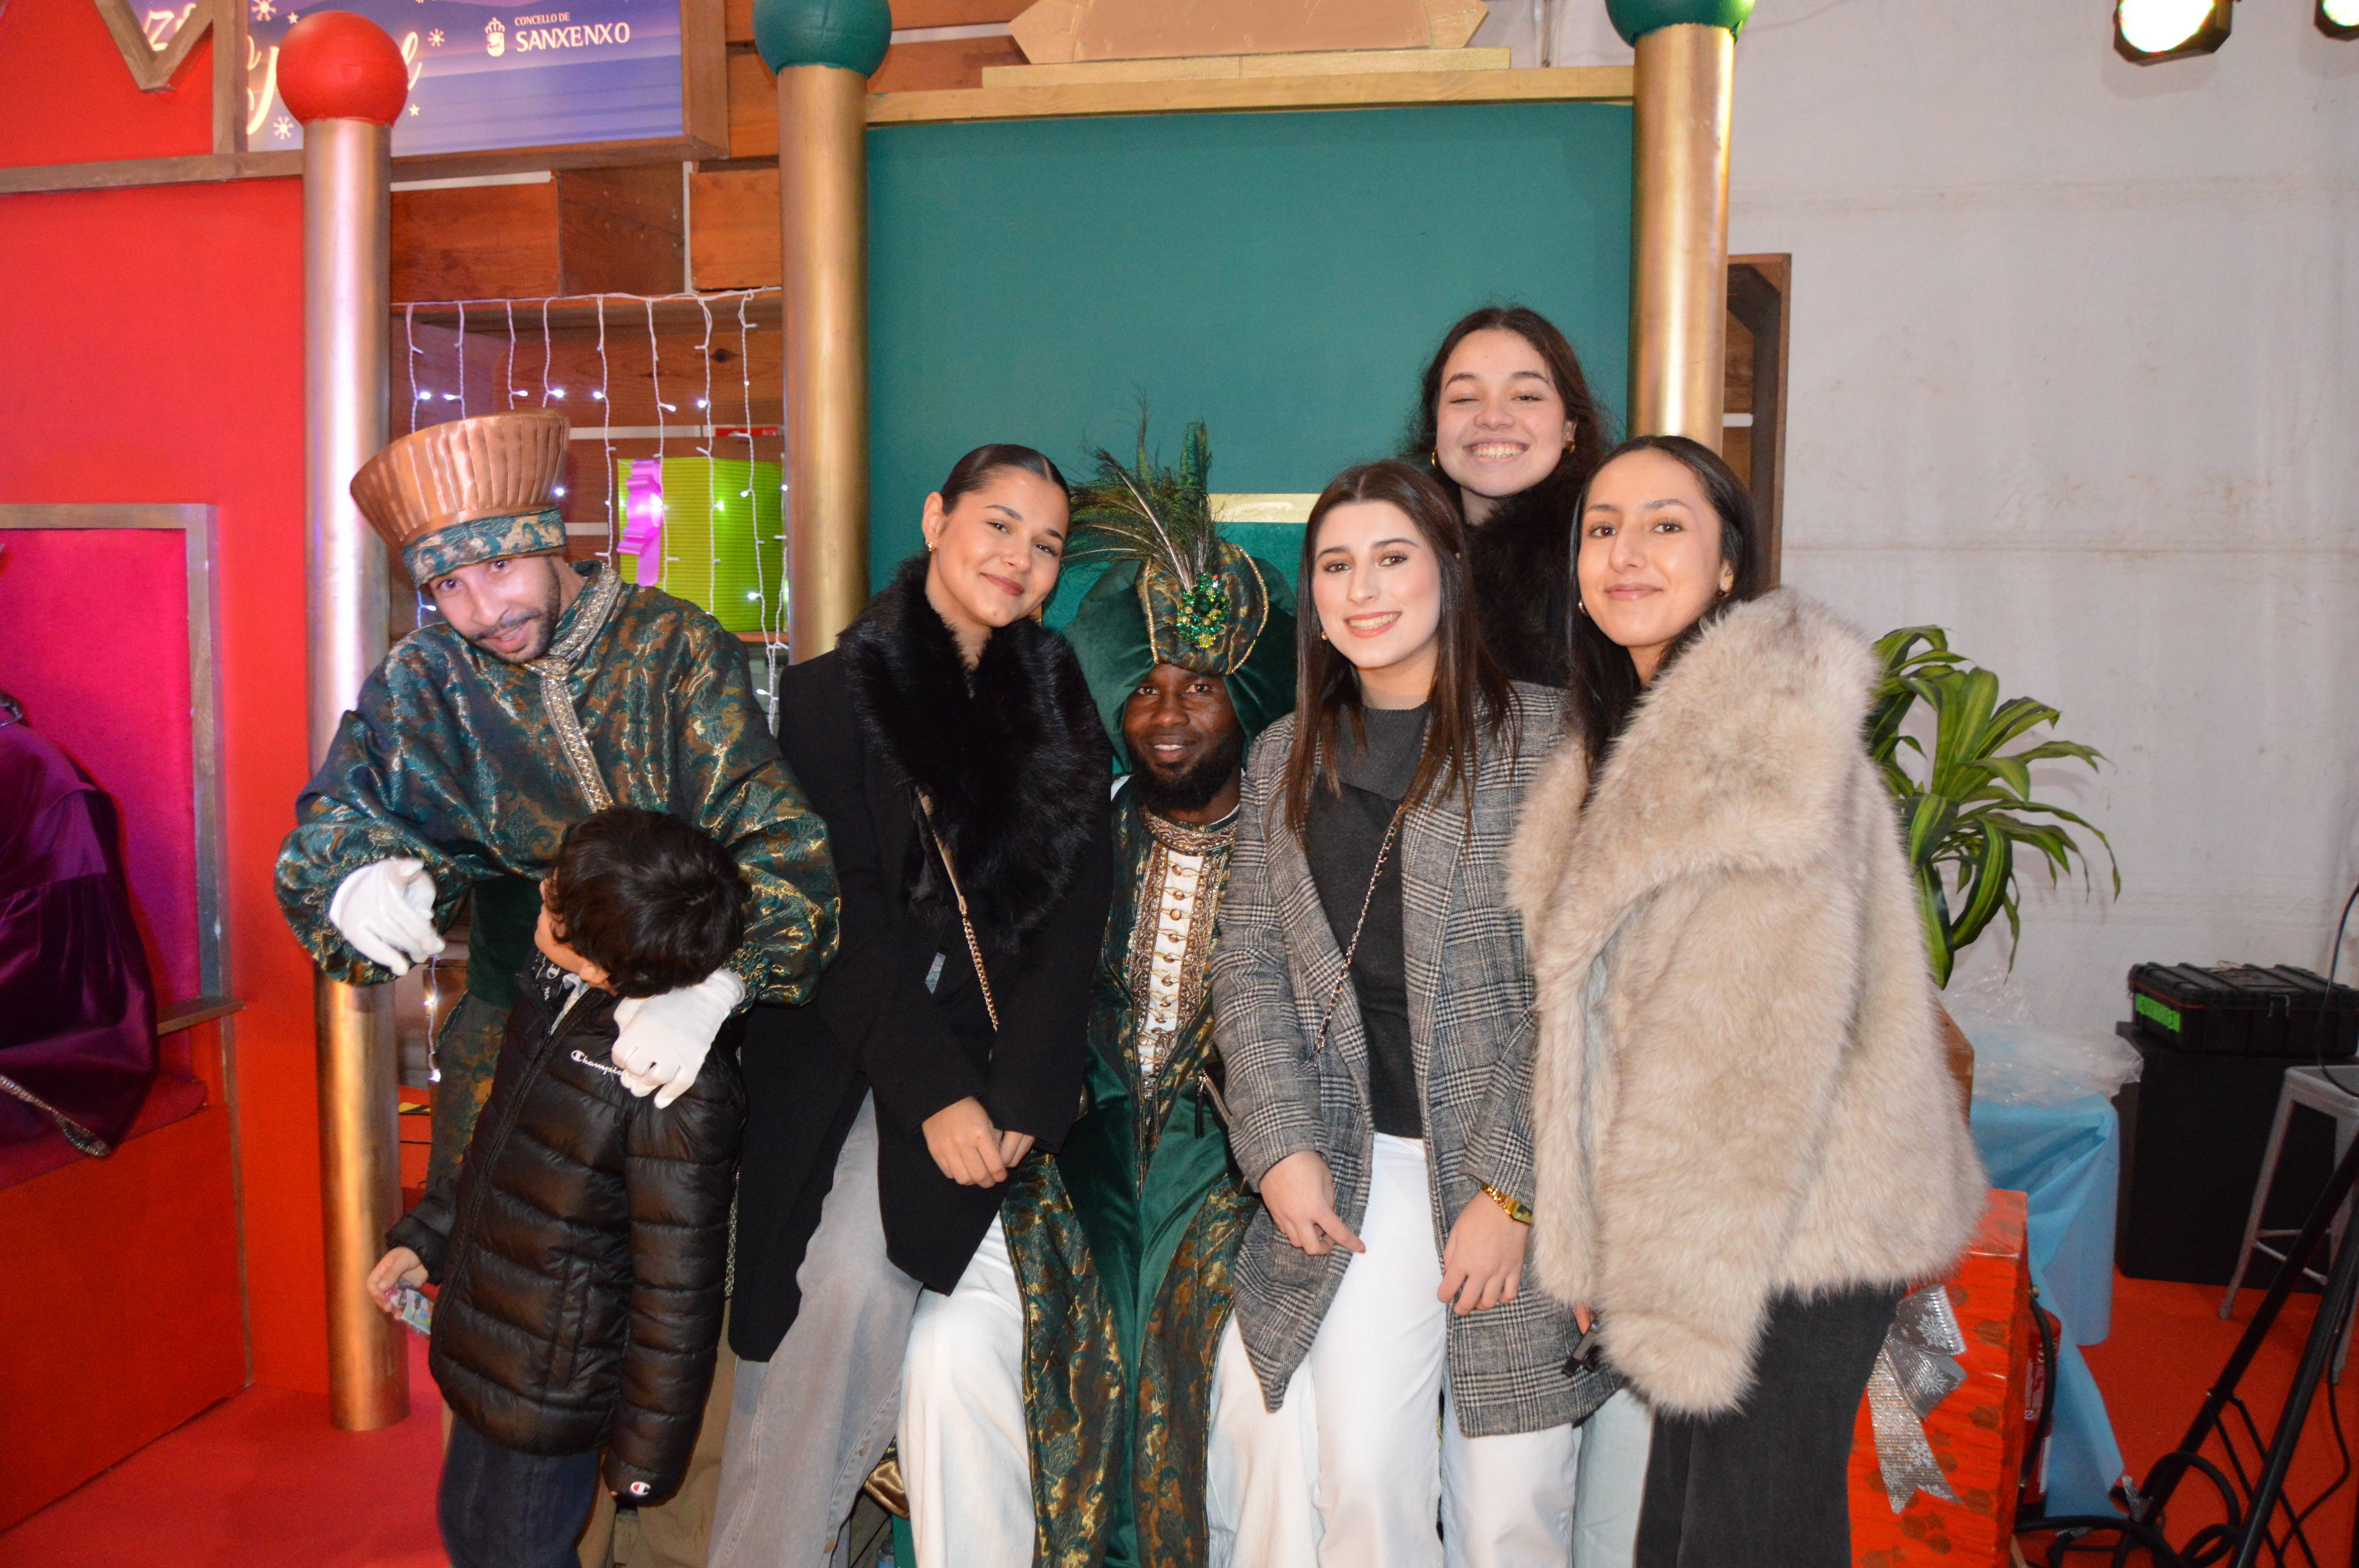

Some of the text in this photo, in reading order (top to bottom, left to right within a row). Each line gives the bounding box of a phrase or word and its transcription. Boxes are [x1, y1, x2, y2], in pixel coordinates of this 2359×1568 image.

[514, 12, 570, 26] CONCELLO DE
[516, 22, 630, 52] SANXENXO
[571, 1050, 622, 1075] Champio
